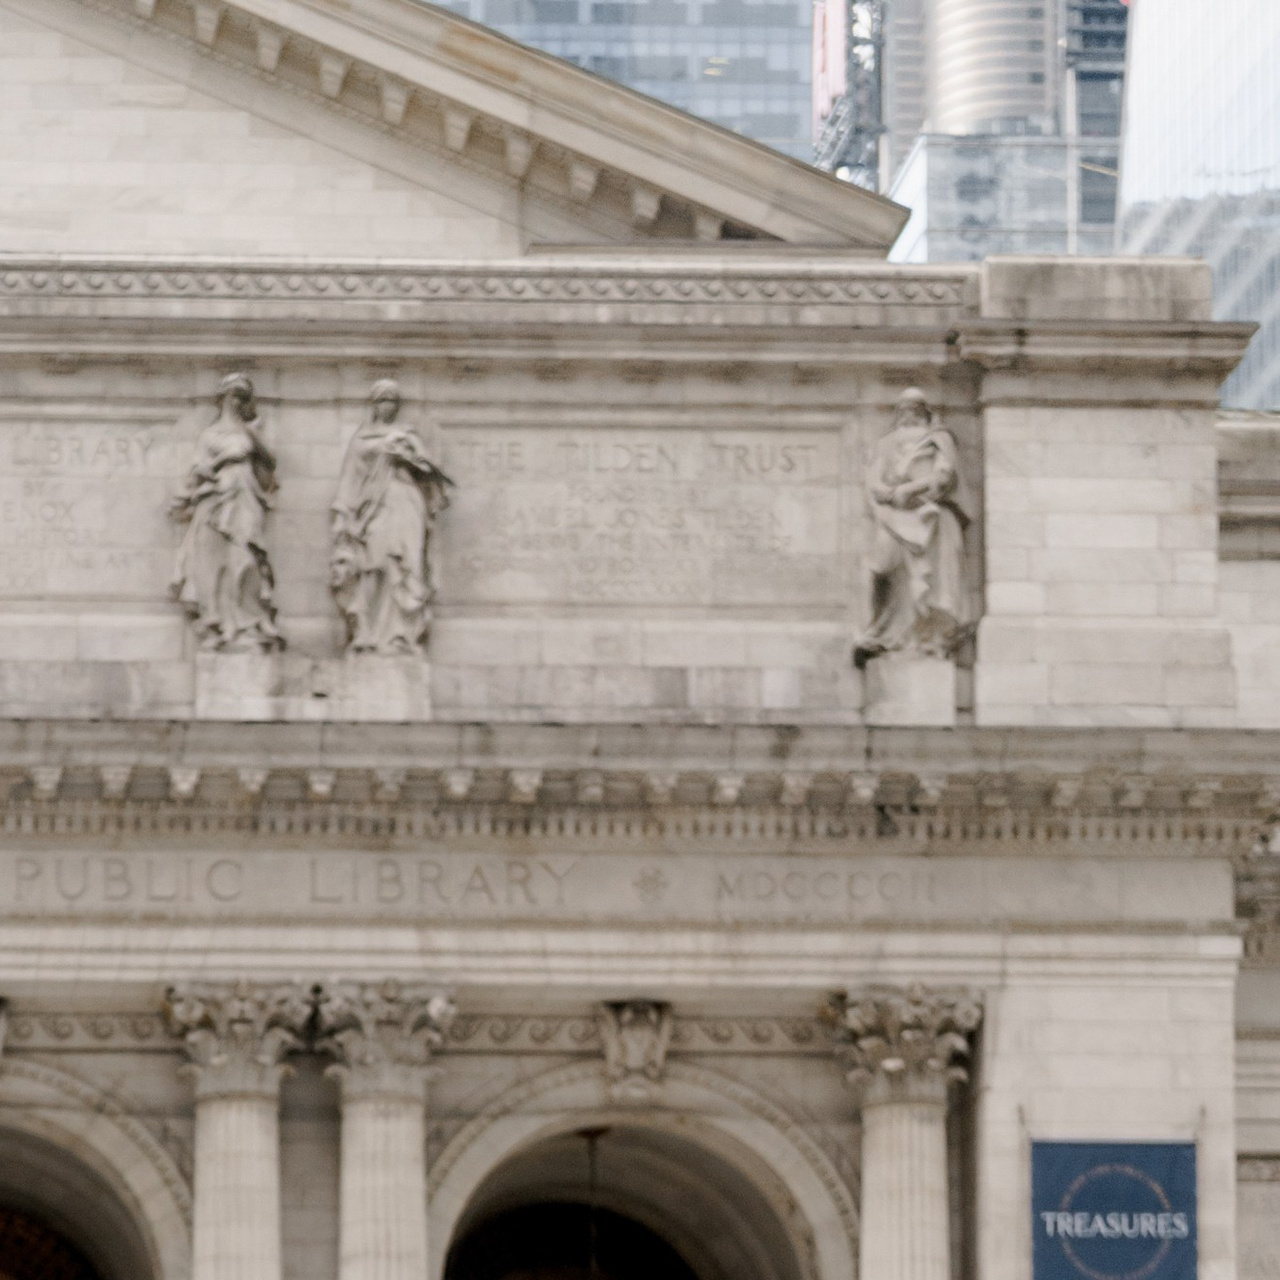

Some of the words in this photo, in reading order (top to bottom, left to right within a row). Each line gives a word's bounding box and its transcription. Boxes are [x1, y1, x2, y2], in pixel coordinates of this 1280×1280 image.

[13, 436, 156, 466] LIBRARY
[710, 443, 818, 475] TRUST
[13, 858, 245, 903] PUBLIC
[308, 858, 578, 905] LIBRARY
[1040, 1211, 1189, 1239] TREASURES
